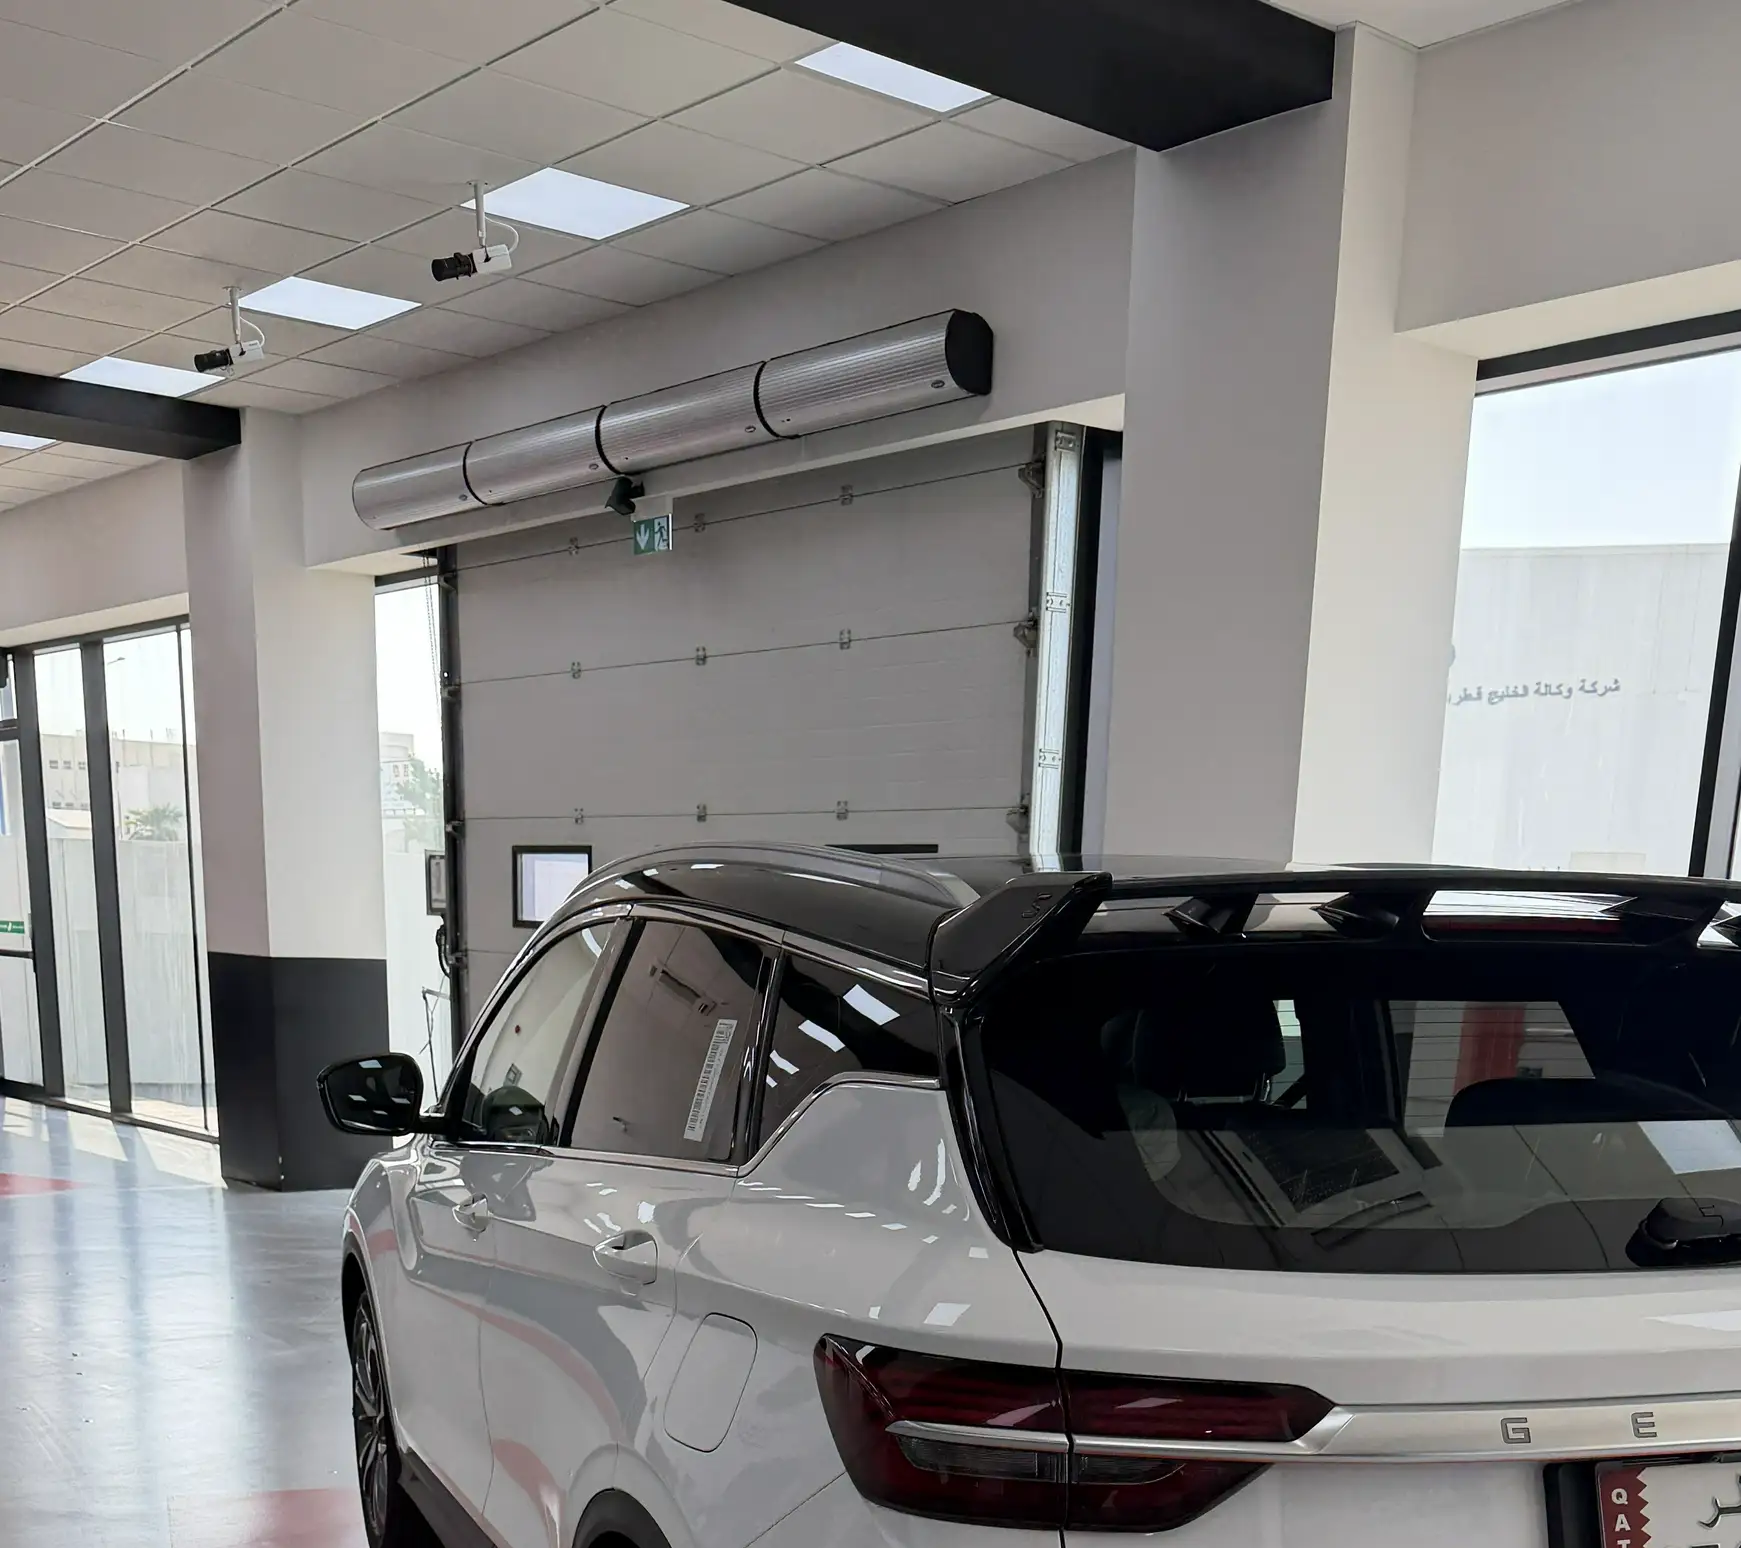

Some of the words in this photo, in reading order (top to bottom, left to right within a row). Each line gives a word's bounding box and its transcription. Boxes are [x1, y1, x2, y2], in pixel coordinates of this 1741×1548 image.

[1452, 686, 1482, 706] قطر
[1487, 684, 1529, 705] الخليج
[1533, 681, 1573, 699] وكالة
[1578, 678, 1621, 697] شركة
